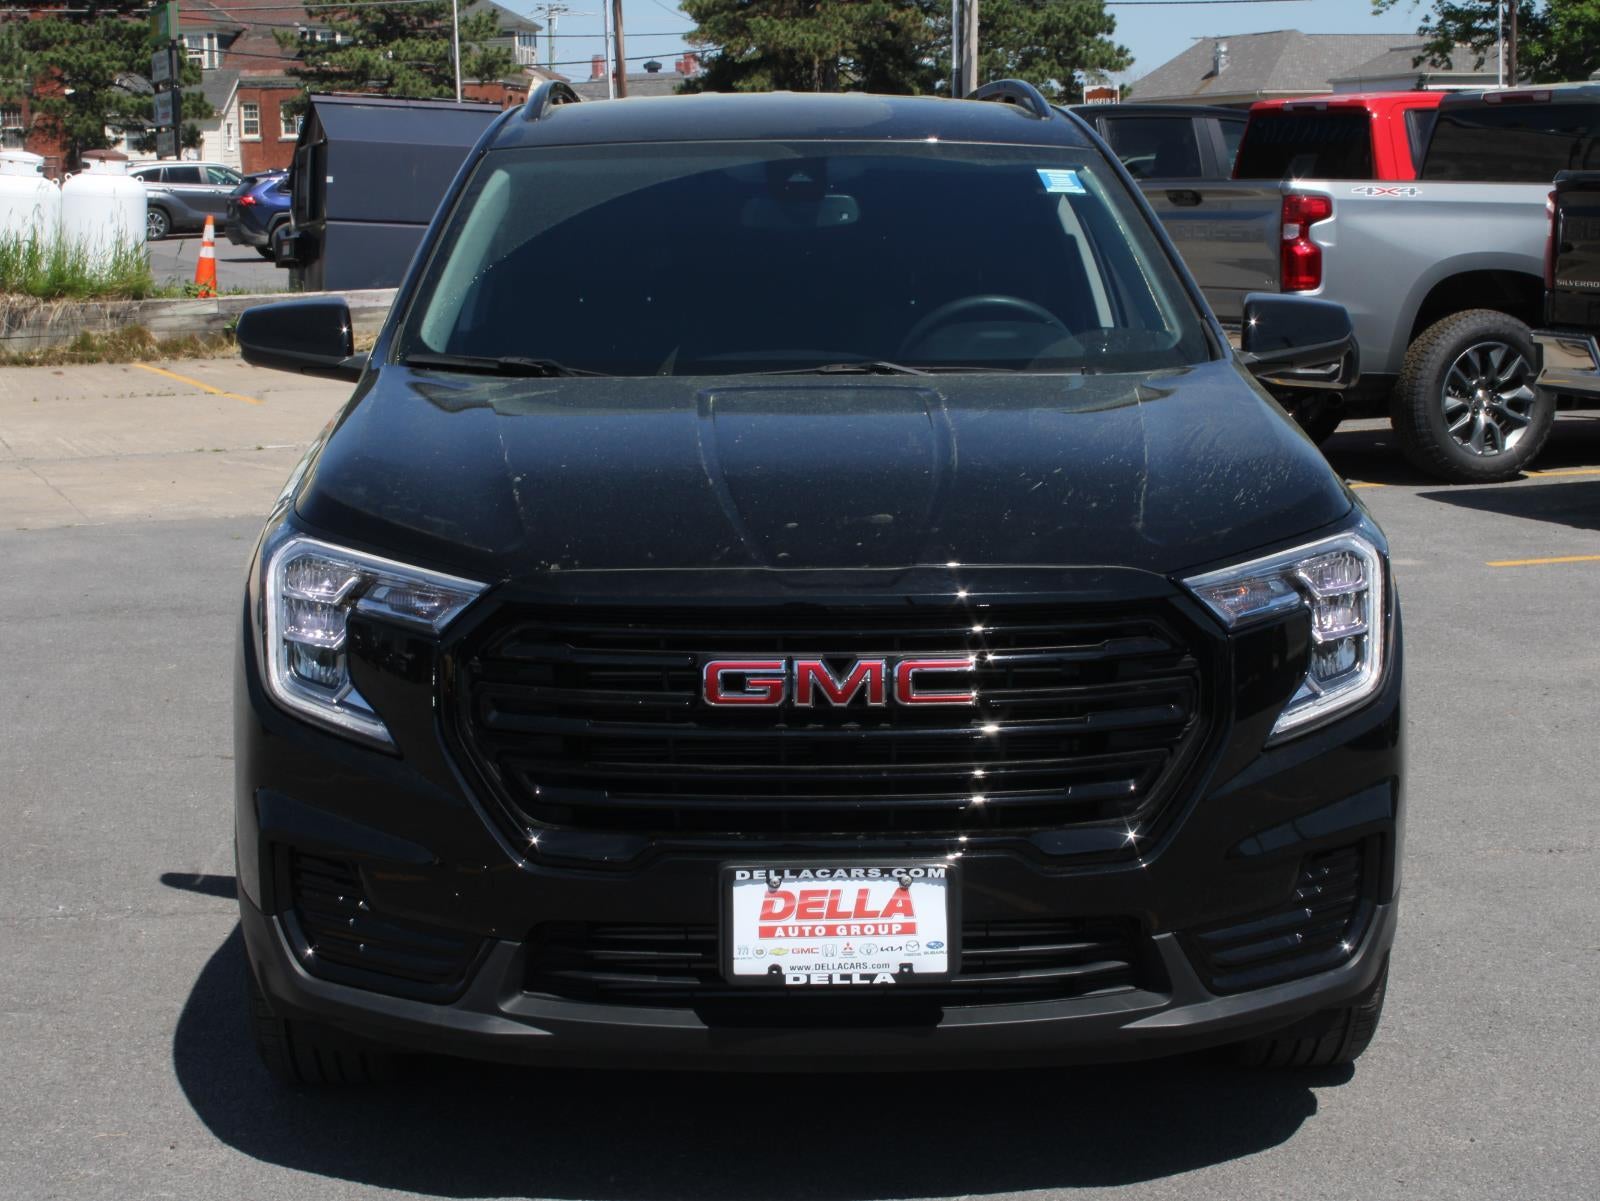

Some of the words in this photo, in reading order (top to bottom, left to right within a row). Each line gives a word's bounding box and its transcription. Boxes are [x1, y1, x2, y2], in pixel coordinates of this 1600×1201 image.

[702, 658, 977, 707] GMC
[735, 868, 946, 880] DELLACARS.COM
[758, 886, 916, 922] DELLA
[774, 925, 826, 937] AUTO
[836, 924, 903, 936] GROUP
[791, 947, 820, 955] GMC
[785, 972, 896, 985] DELLA
